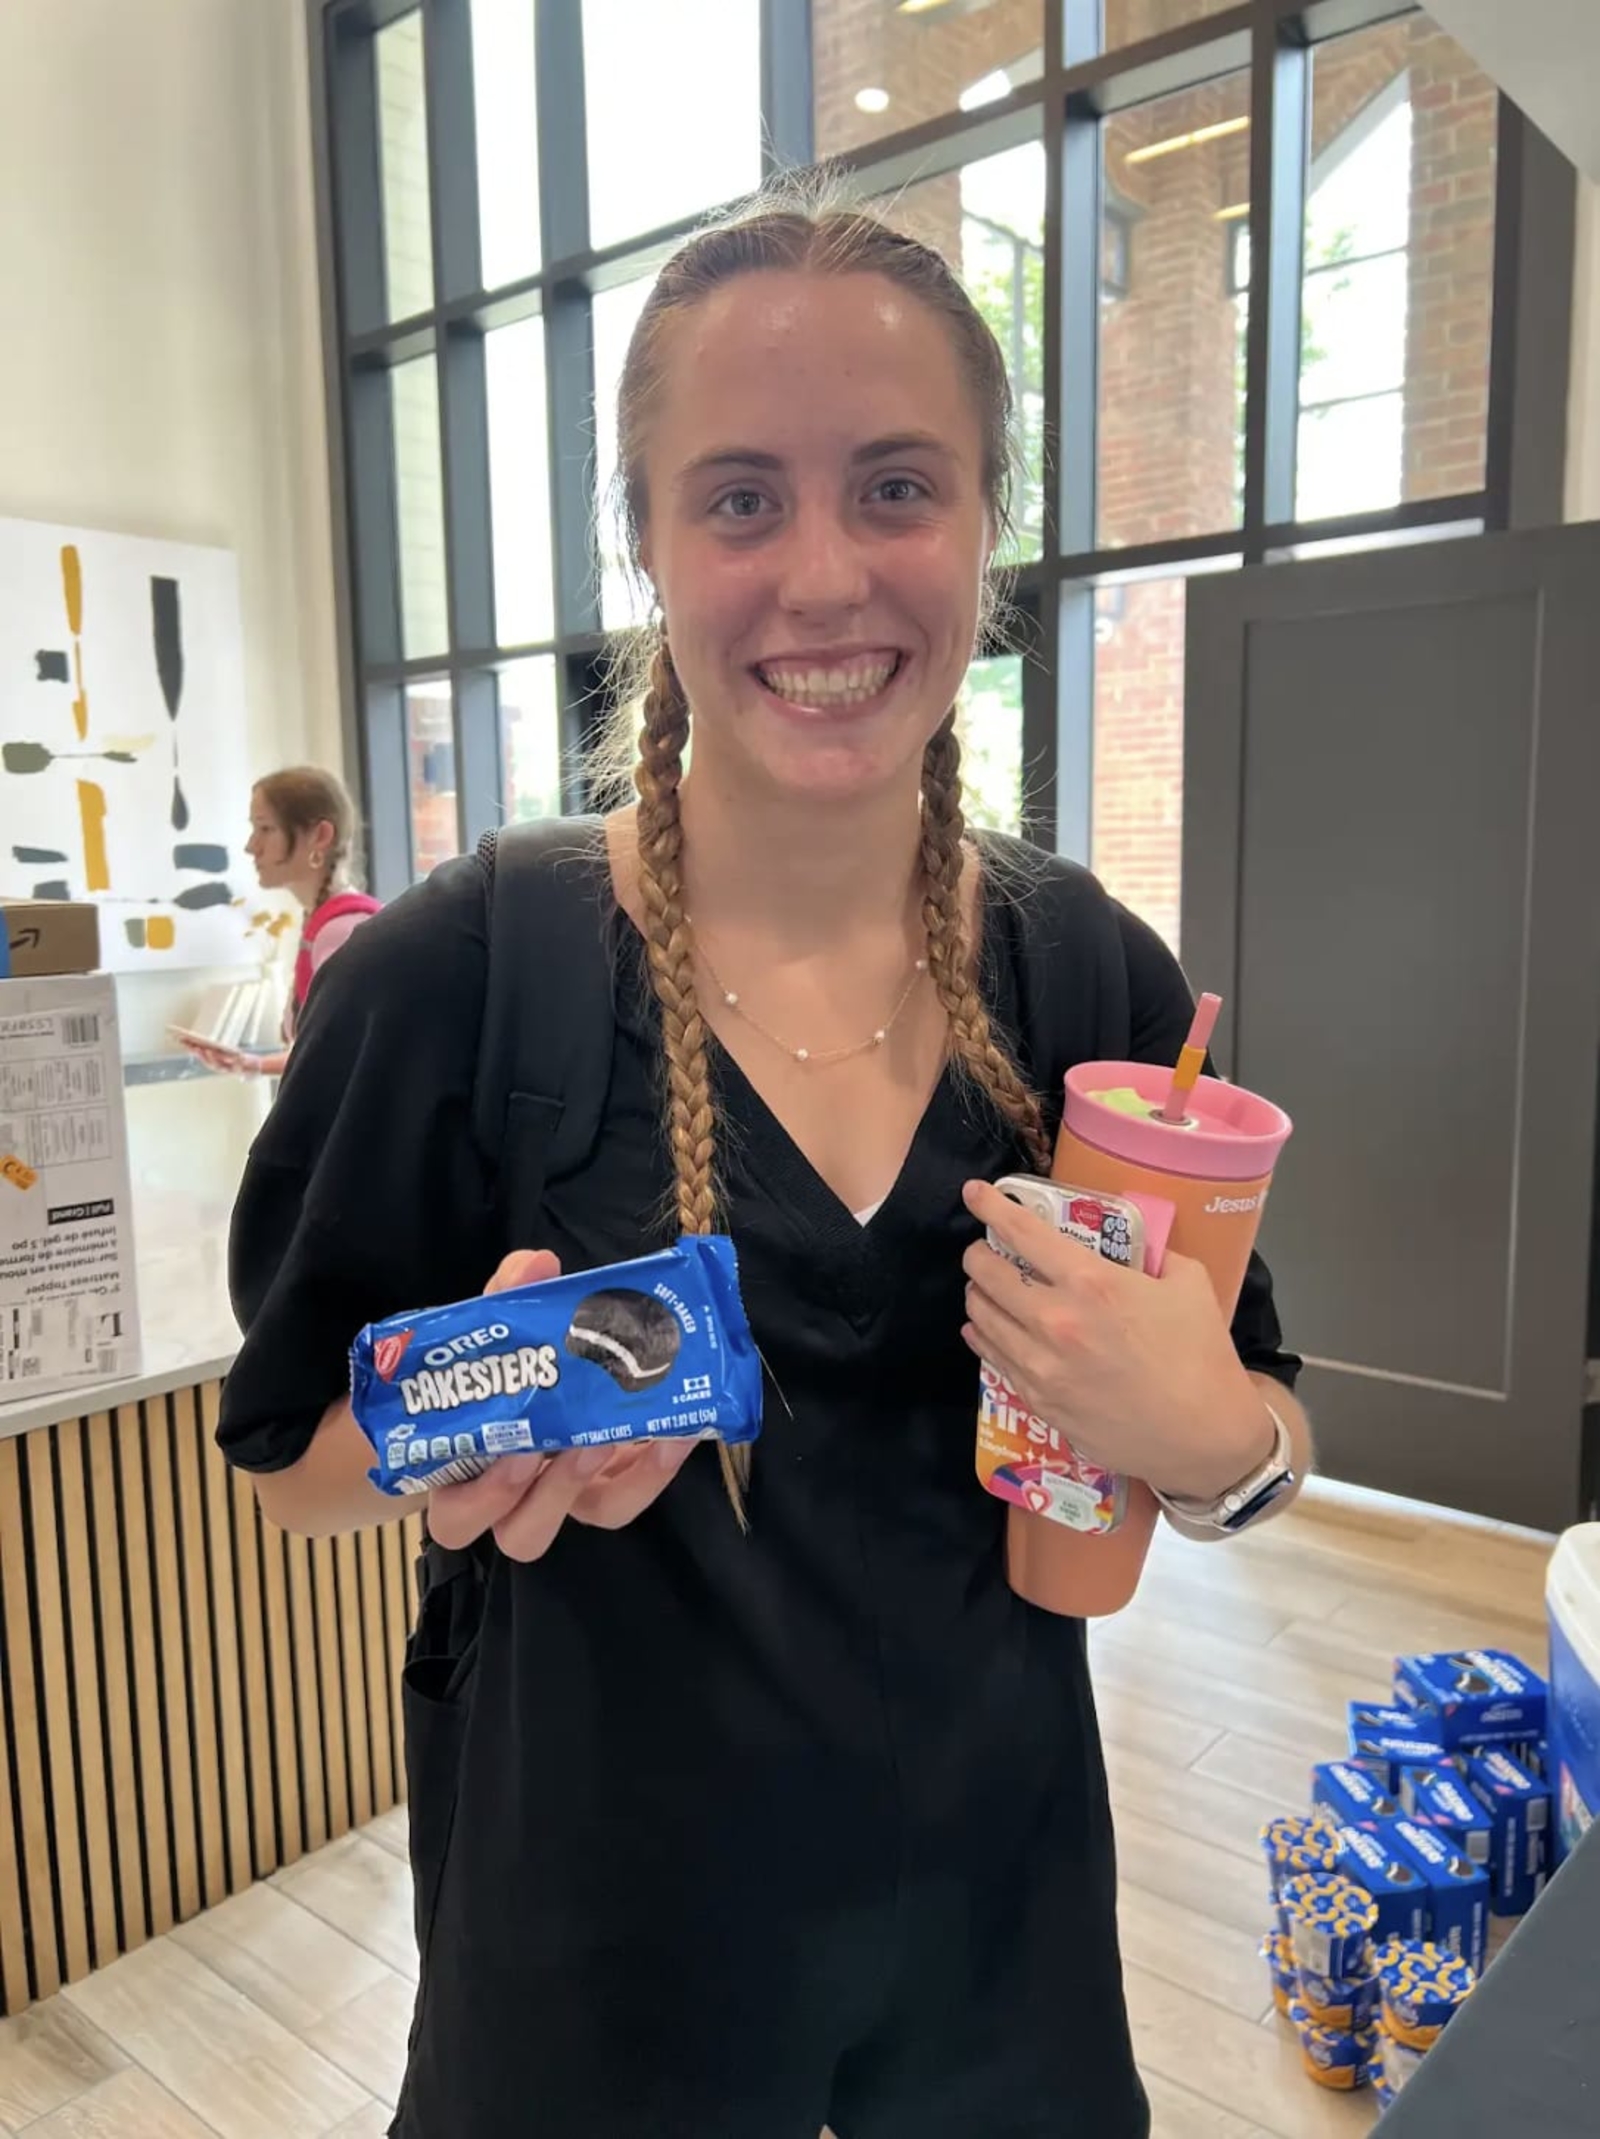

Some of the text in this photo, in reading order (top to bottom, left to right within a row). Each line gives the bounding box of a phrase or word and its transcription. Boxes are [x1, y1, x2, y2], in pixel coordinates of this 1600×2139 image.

[1205, 1196, 1257, 1213] Jesus
[11, 1239, 28, 1251] po
[65, 1232, 79, 1243] de
[37, 1249, 54, 1261] de
[25, 1280, 67, 1295] Topper
[424, 1323, 509, 1366] OREO
[400, 1345, 559, 1415] CAKESTERS
[680, 1389, 712, 1404] CAKES
[646, 1419, 660, 1433] NET
[661, 1417, 673, 1431] WT
[588, 1429, 610, 1444] SNACK
[611, 1424, 633, 1439] CAKES
